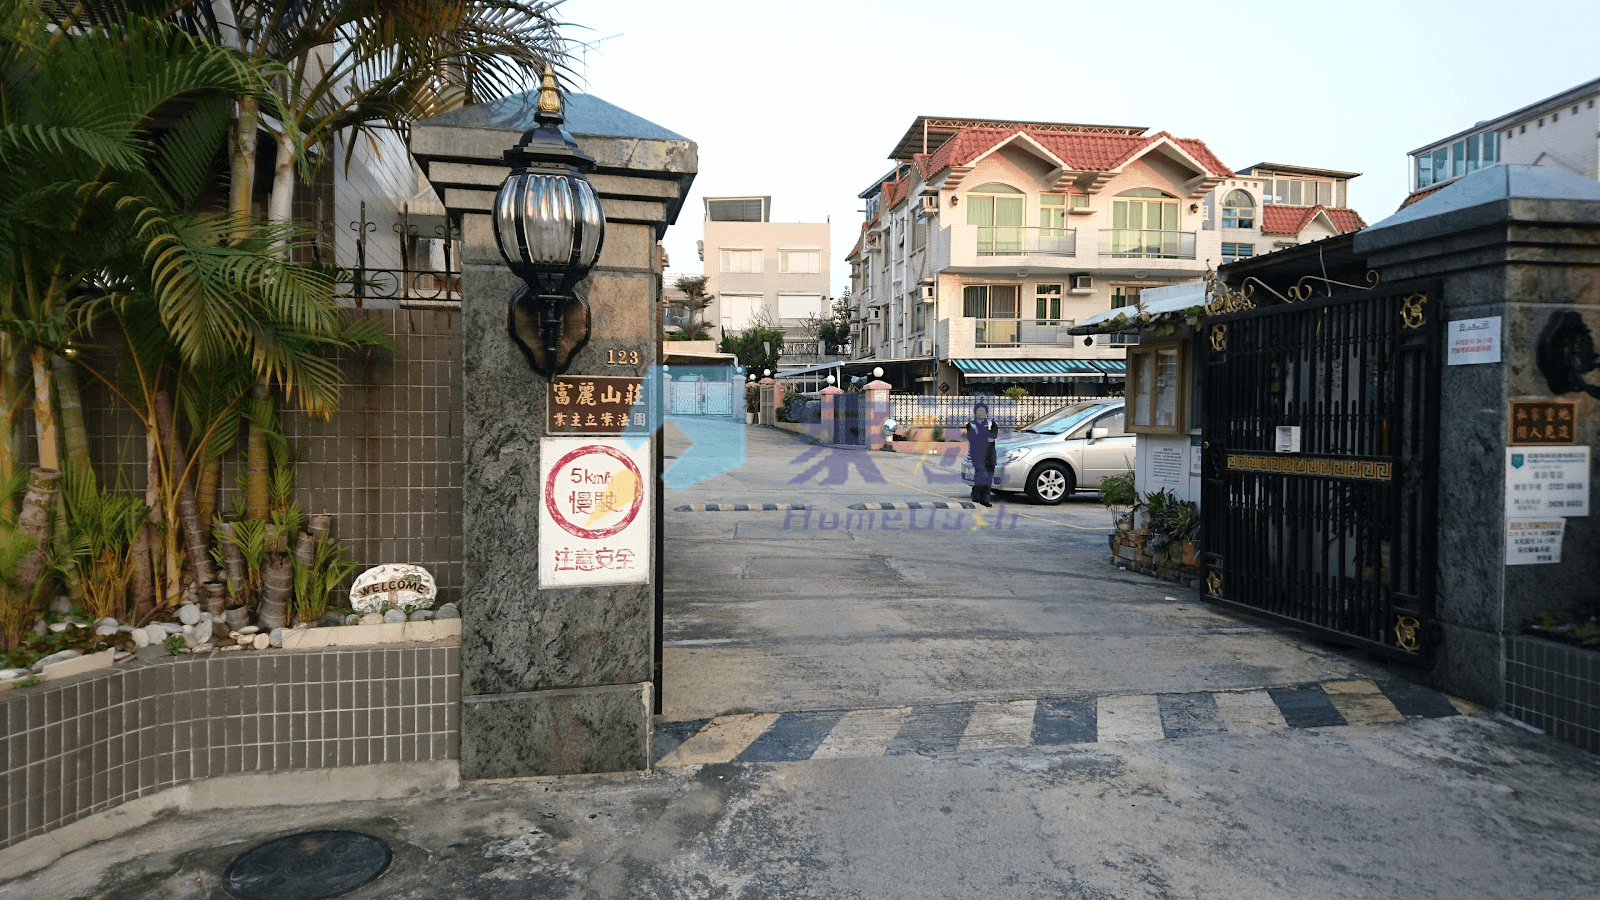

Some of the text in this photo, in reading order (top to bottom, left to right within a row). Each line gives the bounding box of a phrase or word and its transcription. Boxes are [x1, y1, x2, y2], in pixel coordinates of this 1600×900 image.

[607, 350, 639, 365] 123
[553, 381, 645, 406] 富麗山莊
[553, 412, 646, 427] 業主立案法團
[569, 490, 624, 515] 慢駛
[554, 547, 636, 572] 注意安全
[358, 580, 427, 597] WELCOME
